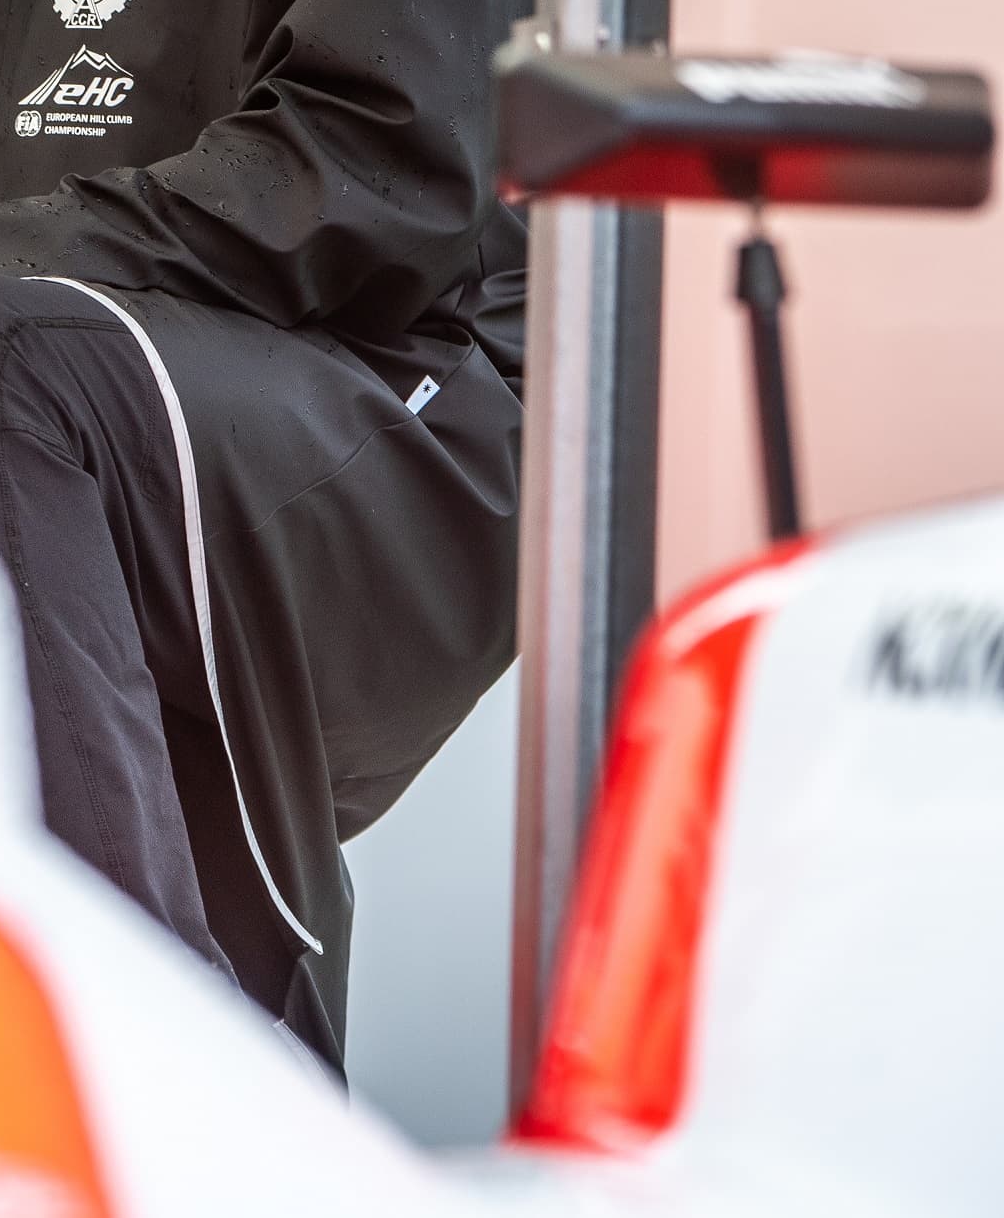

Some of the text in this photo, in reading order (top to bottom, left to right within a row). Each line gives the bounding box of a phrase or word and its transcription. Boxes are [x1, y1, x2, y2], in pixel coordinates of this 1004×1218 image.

[70, 13, 97, 26] CCR
[53, 77, 134, 107] eHC
[46, 113, 133, 124] EUROPEAN HILL CLIMB
[44, 126, 106, 136] CHAMPIONSHIP
